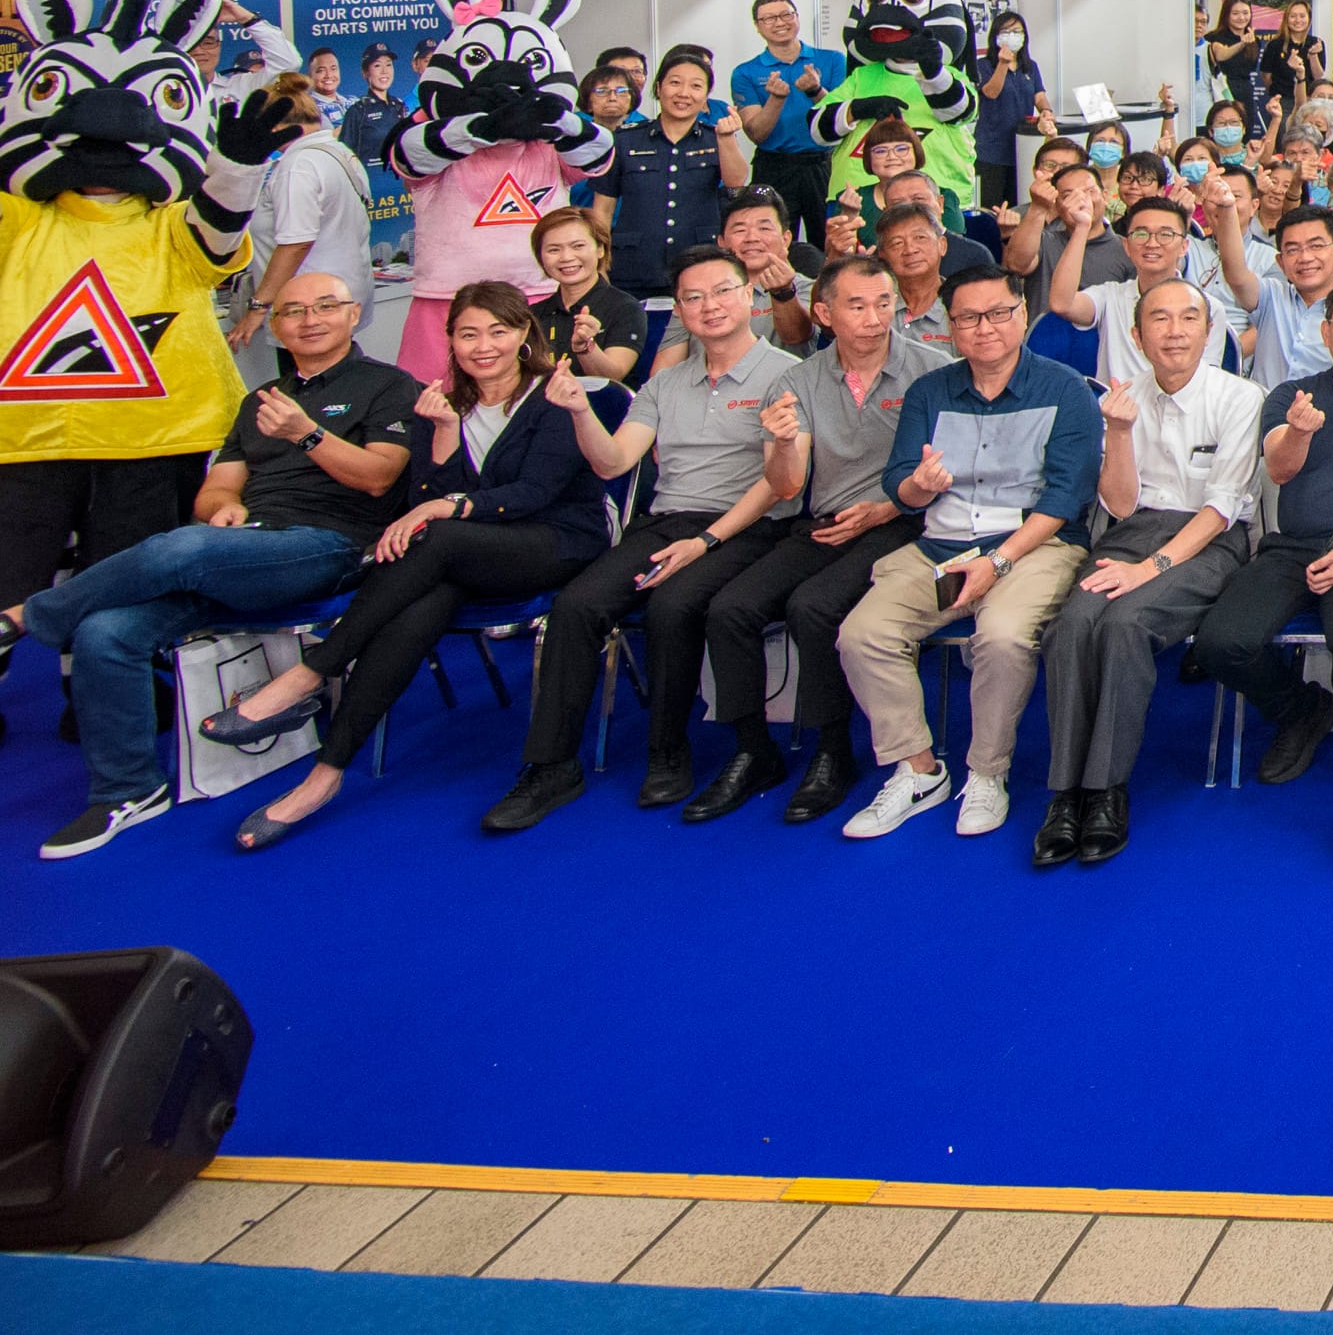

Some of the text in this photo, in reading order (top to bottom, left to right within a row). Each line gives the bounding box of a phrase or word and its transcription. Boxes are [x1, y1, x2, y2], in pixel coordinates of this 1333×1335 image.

[315, 3, 435, 21] OUR COMMUNITY
[312, 17, 439, 36] STARTS WITH YOU
[378, 195, 395, 207] AS
